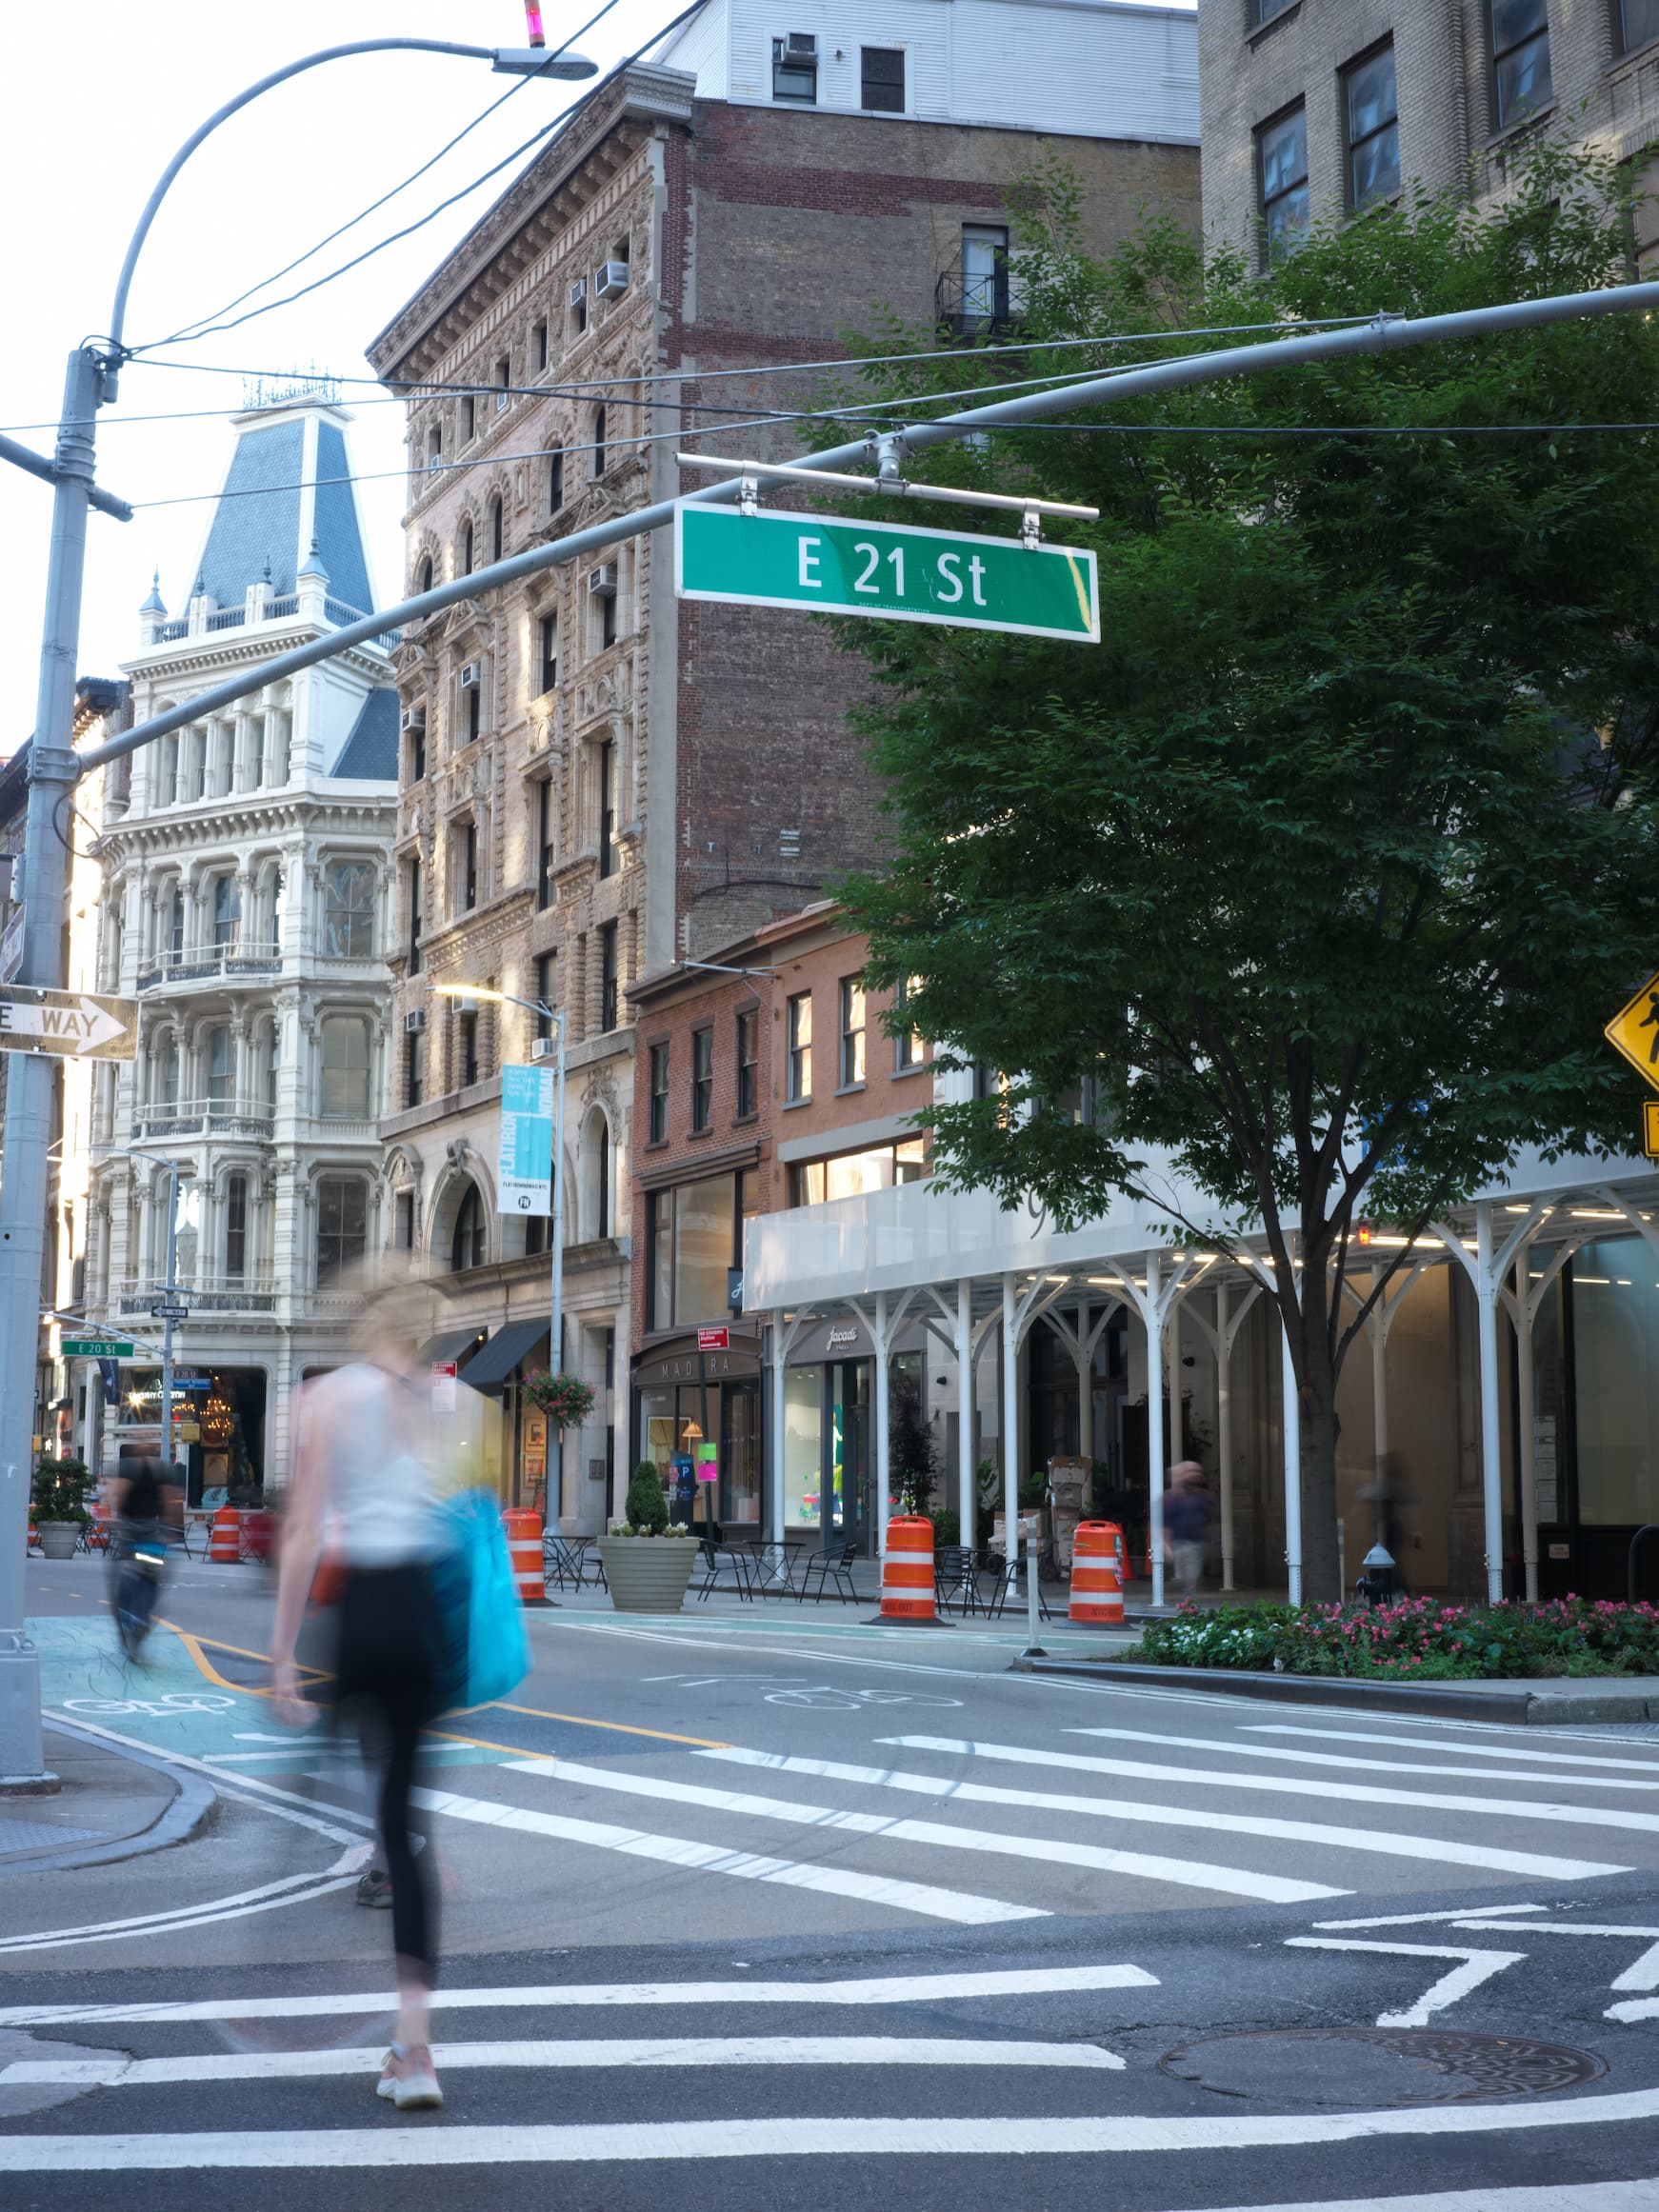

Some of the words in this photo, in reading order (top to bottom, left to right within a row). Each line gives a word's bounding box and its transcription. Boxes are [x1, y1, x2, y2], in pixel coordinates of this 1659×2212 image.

[798, 536, 822, 588] E
[853, 543, 905, 596] 21
[936, 552, 988, 606] St
[42, 1008, 98, 1037] WAY
[79, 1344, 84, 1353] E
[89, 1344, 101, 1353] 20
[106, 1345, 115, 1354] St
[662, 1357, 729, 1379] MADRA
